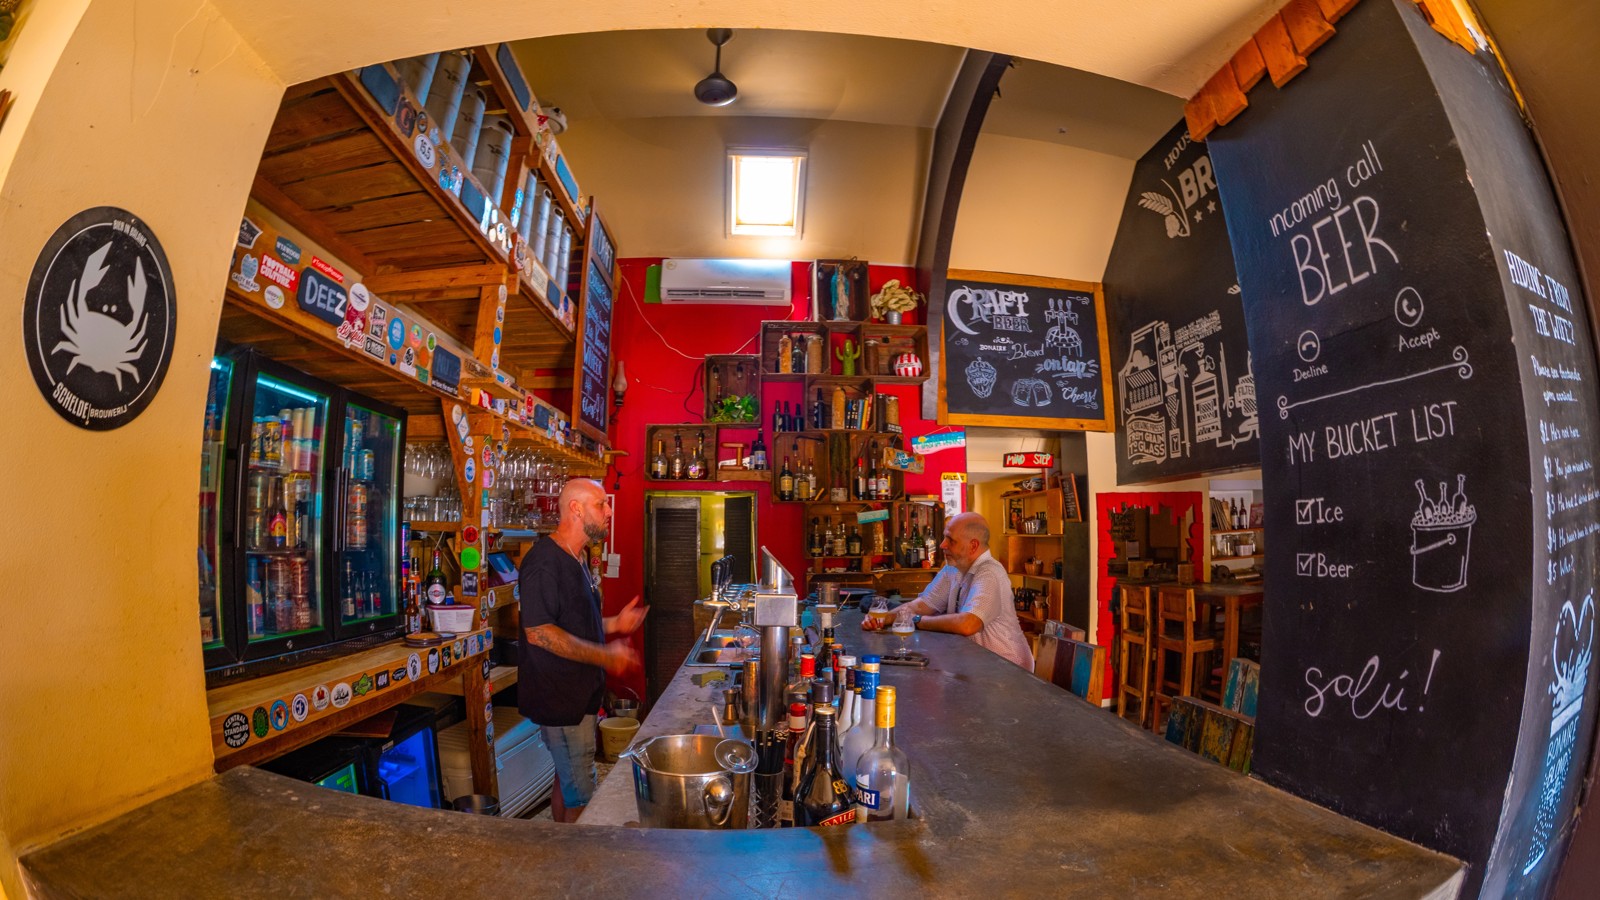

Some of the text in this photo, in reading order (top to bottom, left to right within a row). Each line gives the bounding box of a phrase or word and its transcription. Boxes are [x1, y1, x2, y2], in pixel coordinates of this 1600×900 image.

[1178, 155, 1217, 209] BR
[1269, 139, 1383, 238] incoming call
[1290, 196, 1399, 306] BEER
[304, 275, 348, 319] DEEZ
[947, 285, 1030, 335] CRAFT
[992, 315, 1033, 333] BEER
[1528, 303, 1550, 337] THE
[1399, 327, 1440, 352] Accept
[1293, 362, 1329, 382] Decline
[52, 381, 128, 419] SCHELDE BROUWERIJ
[1062, 388, 1097, 406] Cheers!
[1289, 401, 1457, 465] MY BUCKET LIST
[1032, 453, 1052, 465] STEP
[1316, 497, 1344, 523] Ice
[1316, 553, 1354, 578] Beer
[1546, 558, 1558, 585] $5
[224, 713, 247, 728] CENTRAL
[224, 723, 250, 738] STANDARD
[226, 732, 249, 748] BREWING
